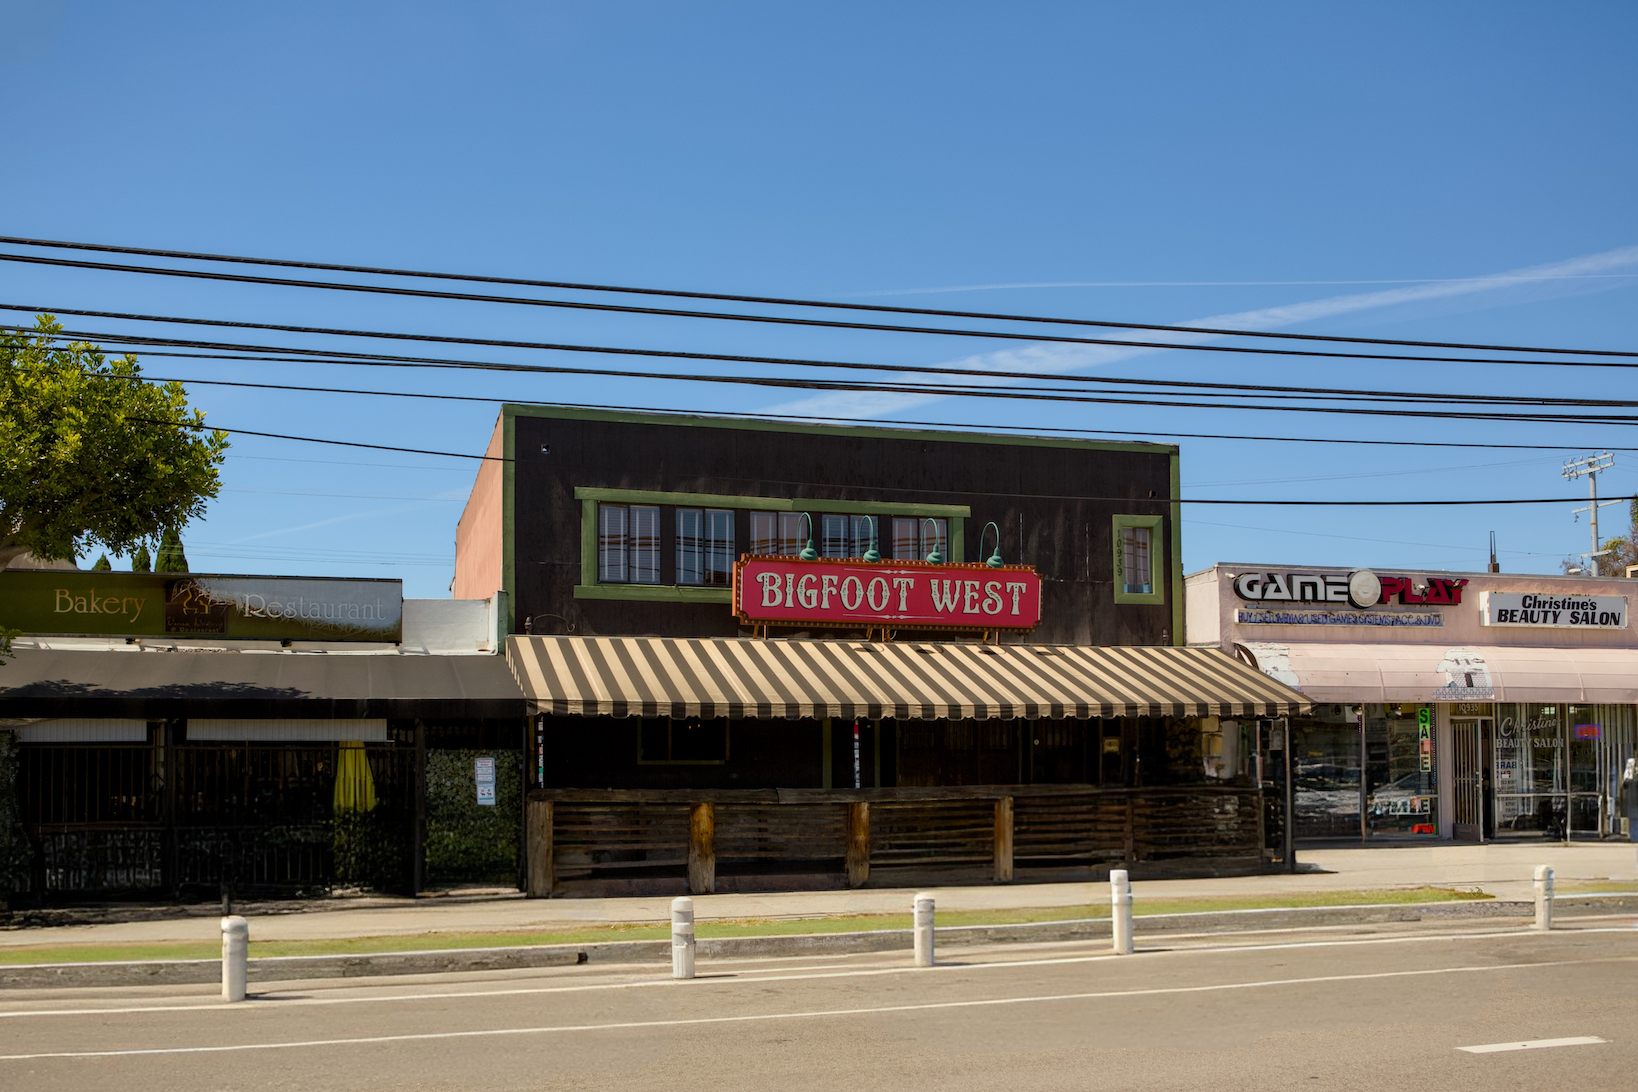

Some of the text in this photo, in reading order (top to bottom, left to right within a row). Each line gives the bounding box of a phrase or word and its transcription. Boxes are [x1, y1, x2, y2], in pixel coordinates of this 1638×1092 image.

[755, 572, 1027, 616] BIGFOOT WEST
[1238, 573, 1468, 604] GAME PLAY
[53, 587, 146, 624] Bakery
[243, 593, 387, 621] Restaurant
[1521, 595, 1597, 611] Christine's
[1239, 612, 1253, 623] BUY
[1306, 614, 1328, 624] USED
[1497, 609, 1621, 626] BEAUTY SALON
[1459, 704, 1479, 712] 10935
[1420, 709, 1430, 771] SALE
[1497, 738, 1564, 748] BEAUTY SALON
